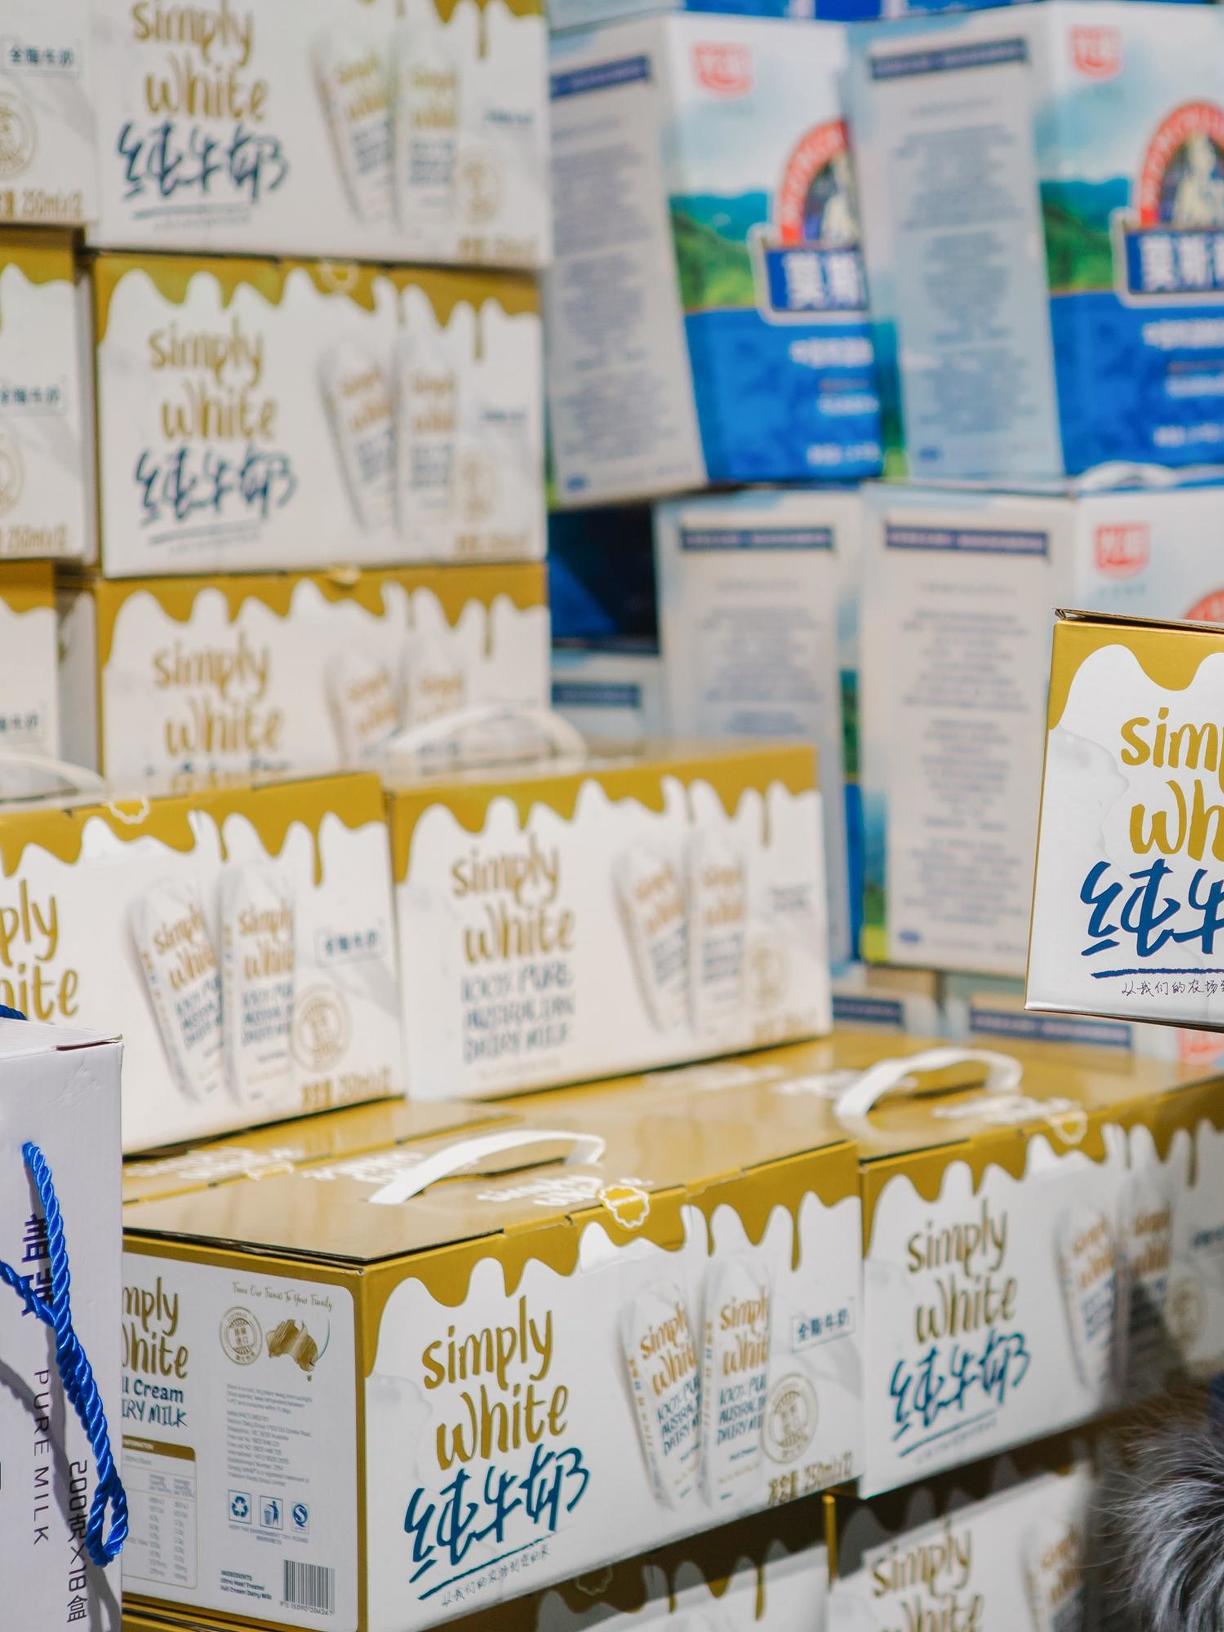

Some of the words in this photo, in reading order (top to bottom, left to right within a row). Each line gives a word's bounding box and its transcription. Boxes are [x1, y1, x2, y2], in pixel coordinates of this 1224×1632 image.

[134, 0, 252, 66] simply
[146, 52, 268, 121] white
[148, 315, 263, 388] simply
[160, 382, 275, 440] white
[154, 630, 270, 697] simply
[165, 697, 284, 755] white
[452, 834, 558, 902] simply
[0, 879, 58, 967] ply
[465, 905, 575, 966] white
[0, 963, 78, 1021] ite
[907, 1197, 1007, 1277] simply
[121, 1276, 179, 1336] mply
[915, 1274, 1018, 1343] white
[122, 1322, 188, 1379] hite
[421, 1295, 553, 1392] simply
[33, 1369, 50, 1457] PURE
[121, 1398, 145, 1423] IRY
[148, 1402, 188, 1428] MILK
[133, 1379, 184, 1404] Cream
[436, 1384, 569, 1471] white
[33, 1466, 50, 1546] MILK
[404, 1443, 590, 1584] 纯牛奶
[870, 1518, 971, 1597] simply
